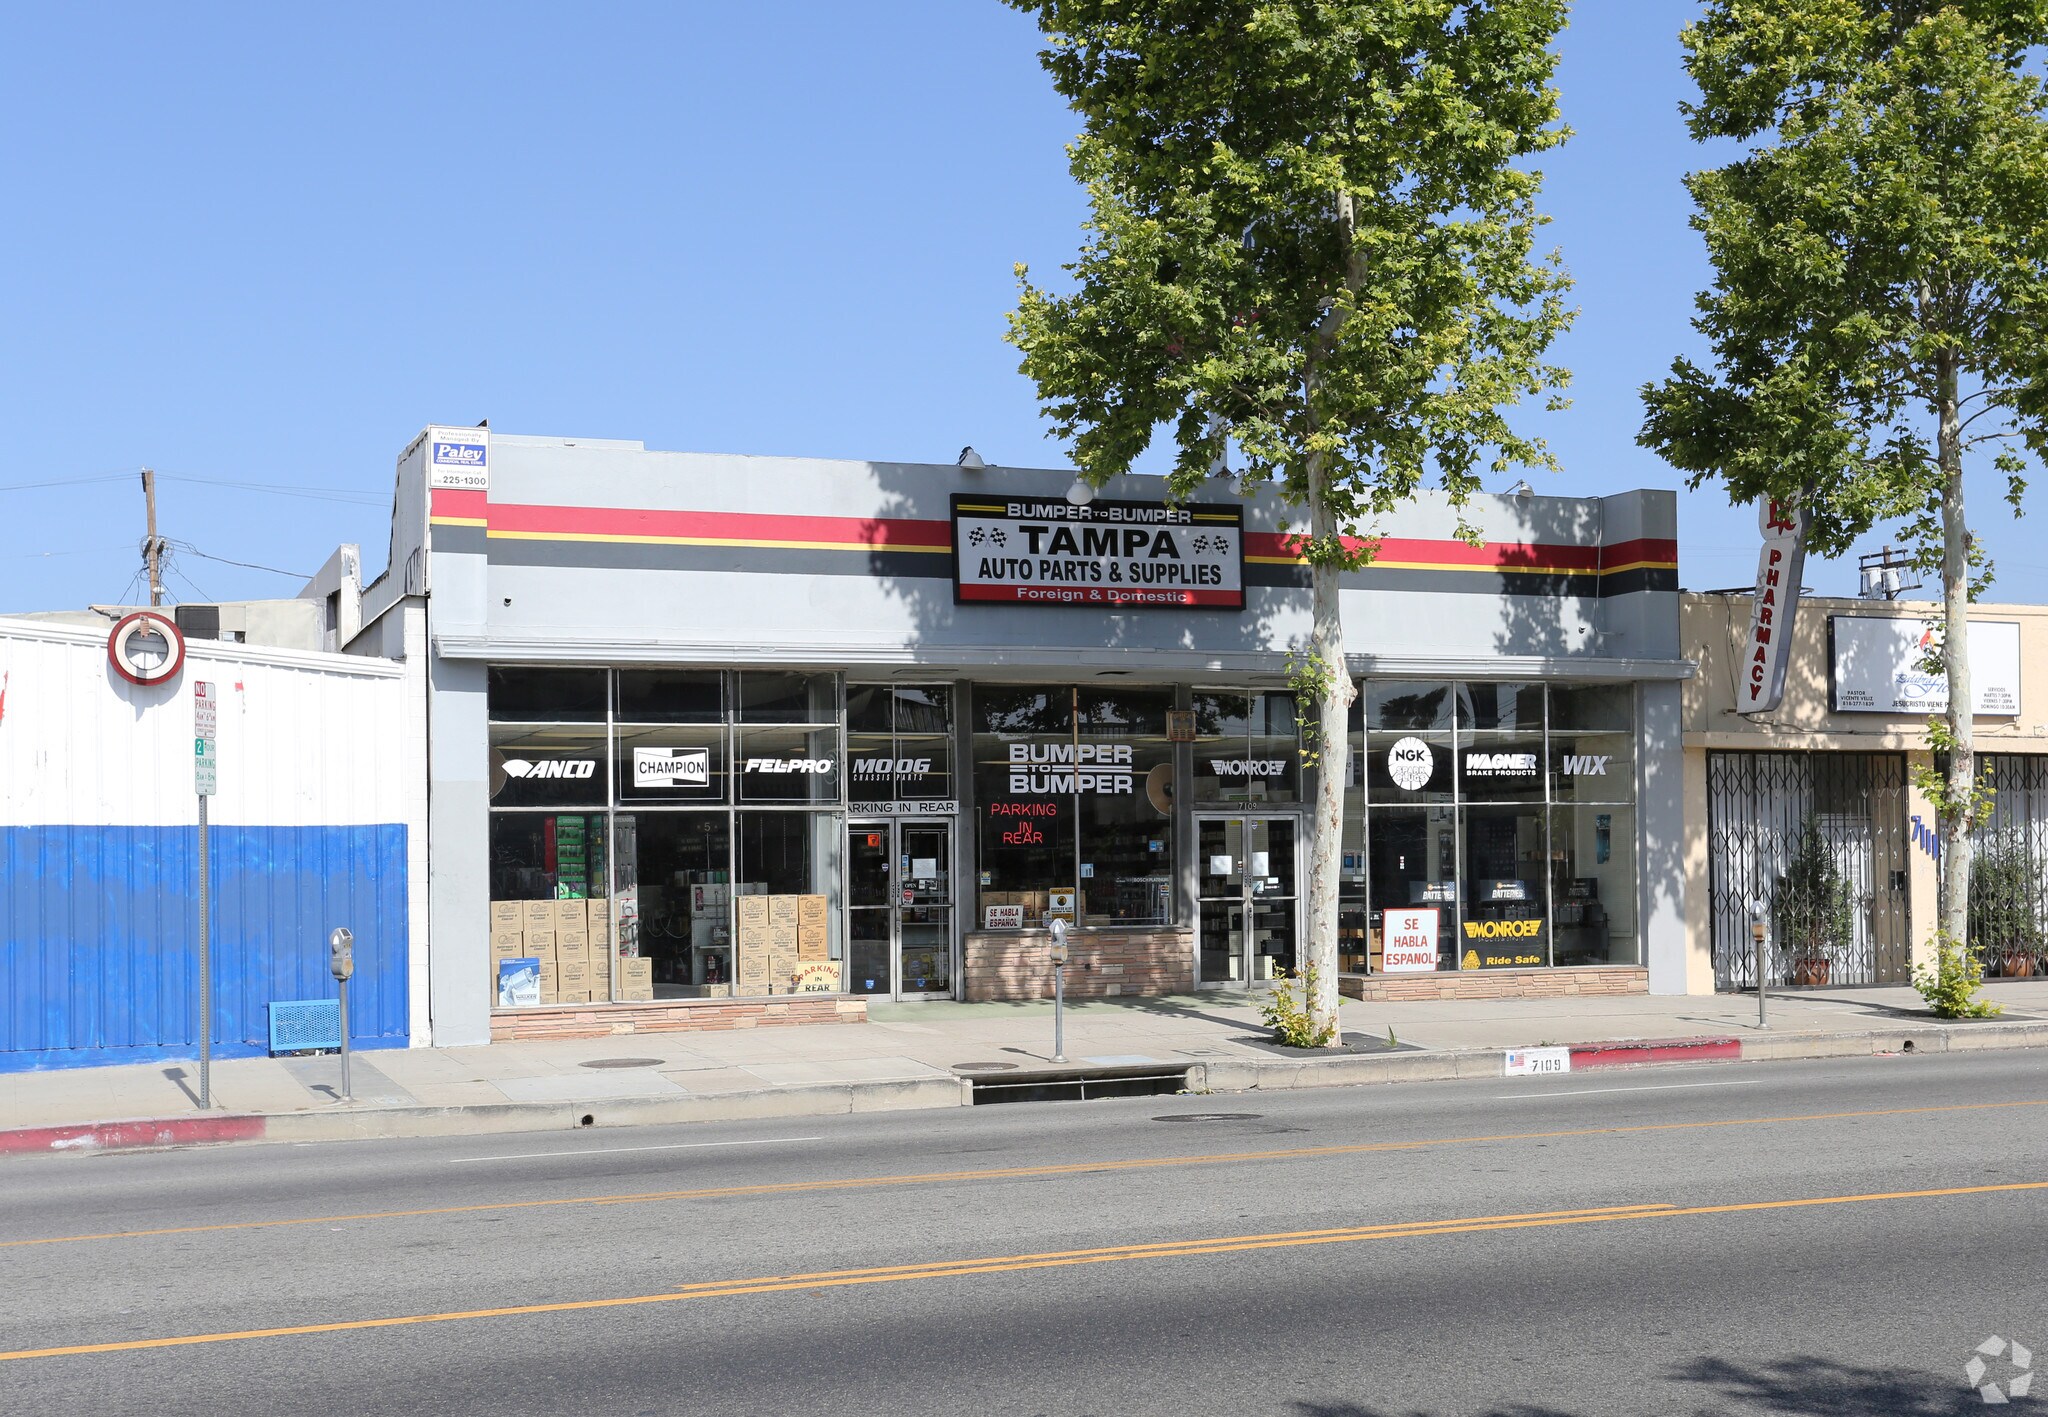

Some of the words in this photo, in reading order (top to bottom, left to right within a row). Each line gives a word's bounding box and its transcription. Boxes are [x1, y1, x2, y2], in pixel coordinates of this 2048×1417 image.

[437, 444, 483, 460] Paley
[443, 476, 486, 485] 225-1300
[1008, 503, 1092, 520] BUMPER
[1109, 508, 1191, 523] BUMPER
[1018, 525, 1181, 559] TAMPA
[978, 557, 1033, 580] AUTO
[1040, 560, 1101, 582] PARTS
[1109, 562, 1123, 582] &
[1129, 562, 1222, 585] SUPPLIES
[1017, 587, 1082, 602] Foreign
[1090, 590, 1101, 600] &
[1107, 590, 1187, 602] Domestic
[1749, 549, 1782, 700] PHARMACY
[195, 682, 205, 696] NO
[195, 699, 215, 711] PARKING
[197, 741, 202, 753] 2
[1009, 744, 1132, 763] BUMPER
[1396, 750, 1425, 761] NGK
[1466, 753, 1536, 769] WAGNER
[195, 758, 215, 769] PARKING
[525, 760, 595, 779] ANCO
[639, 761, 705, 775] CHAMPION
[744, 758, 833, 774] FEL-PRO
[852, 758, 931, 774] MOOG
[1028, 764, 1051, 773] TO
[1220, 760, 1277, 775] MONROE
[1396, 766, 1425, 774] SPARK
[1563, 755, 1608, 775] WIX
[1009, 774, 1132, 794] BUMPER
[1396, 773, 1426, 782] PLUGS
[848, 803, 893, 813] ARKING
[900, 803, 911, 812] IN
[919, 802, 954, 813] REAR
[991, 803, 1057, 816] PARKING
[1019, 821, 1033, 834] IN
[1003, 831, 1043, 844] REAR
[1492, 889, 1523, 899] BATTERIES
[990, 908, 997, 917] SE
[1000, 908, 1019, 917] HABLA
[989, 916, 1018, 927] ESPAÑOL
[1404, 918, 1419, 930] SE
[1474, 920, 1532, 938] MONROE
[1394, 935, 1428, 948] HABLA
[1386, 952, 1434, 965] ESPANOL
[1486, 956, 1511, 965] Ride
[1515, 955, 1540, 965] Safe
[799, 965, 840, 980] PARKING
[805, 984, 830, 992] REAR
[1532, 1059, 1561, 1072] 7109
